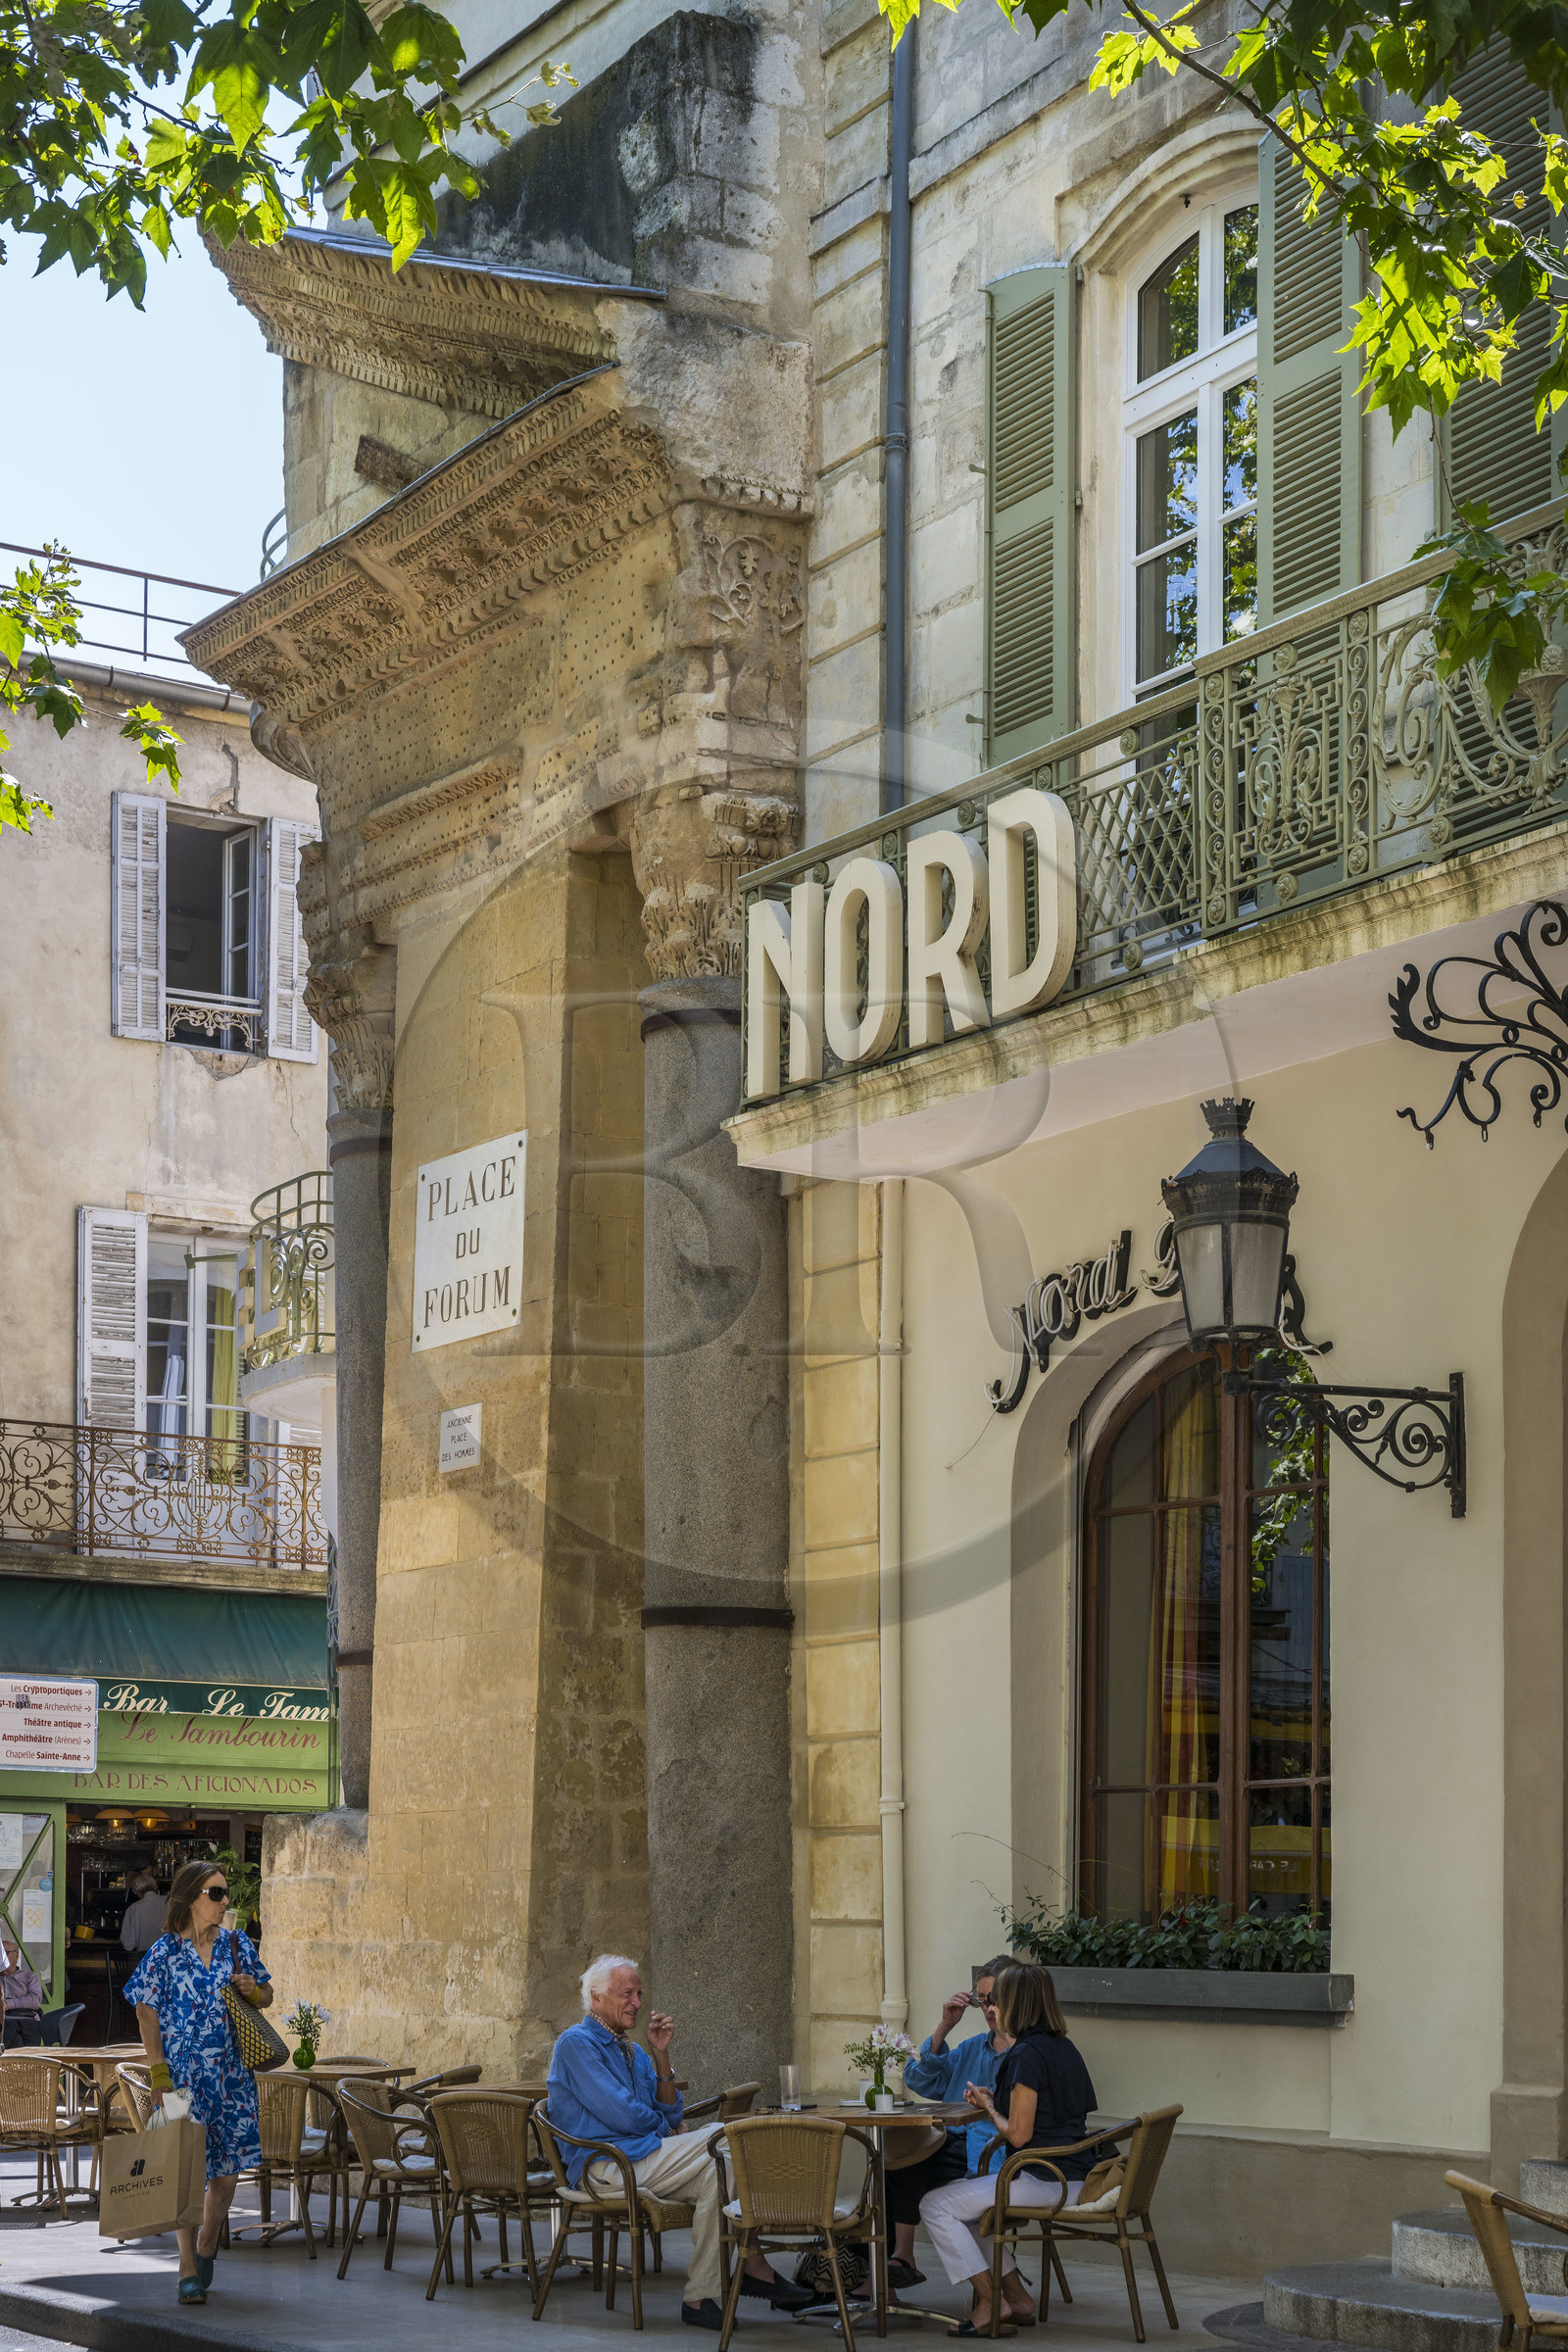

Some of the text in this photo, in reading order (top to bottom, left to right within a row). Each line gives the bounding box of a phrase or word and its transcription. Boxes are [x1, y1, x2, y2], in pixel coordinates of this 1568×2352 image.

[747, 788, 1077, 1101] NORD
[427, 1155, 516, 1222] PLACE
[456, 1227, 481, 1259] DU
[423, 1265, 512, 1328] FORUM
[984, 1230, 1138, 1413] Nord
[447, 1415, 472, 1429] ANCIENNE
[451, 1433, 467, 1444] PLACE
[442, 1447, 475, 1462] DES HOMMES
[23, 1685, 83, 1696] Cryptoportiques
[44, 1702, 82, 1712] Archevêché
[104, 1684, 169, 1712] Bar
[202, 1689, 244, 1716] Le
[24, 1717, 82, 1729] Théâtre antique
[116, 1711, 321, 1749] Le Tambourin
[2, 1733, 81, 1745] Amphithéâtre (Arènes)
[5, 1750, 81, 1761] Chapelle Sainte-Anne
[74, 1772, 318, 1794] BAR DES AFICIONADOS
